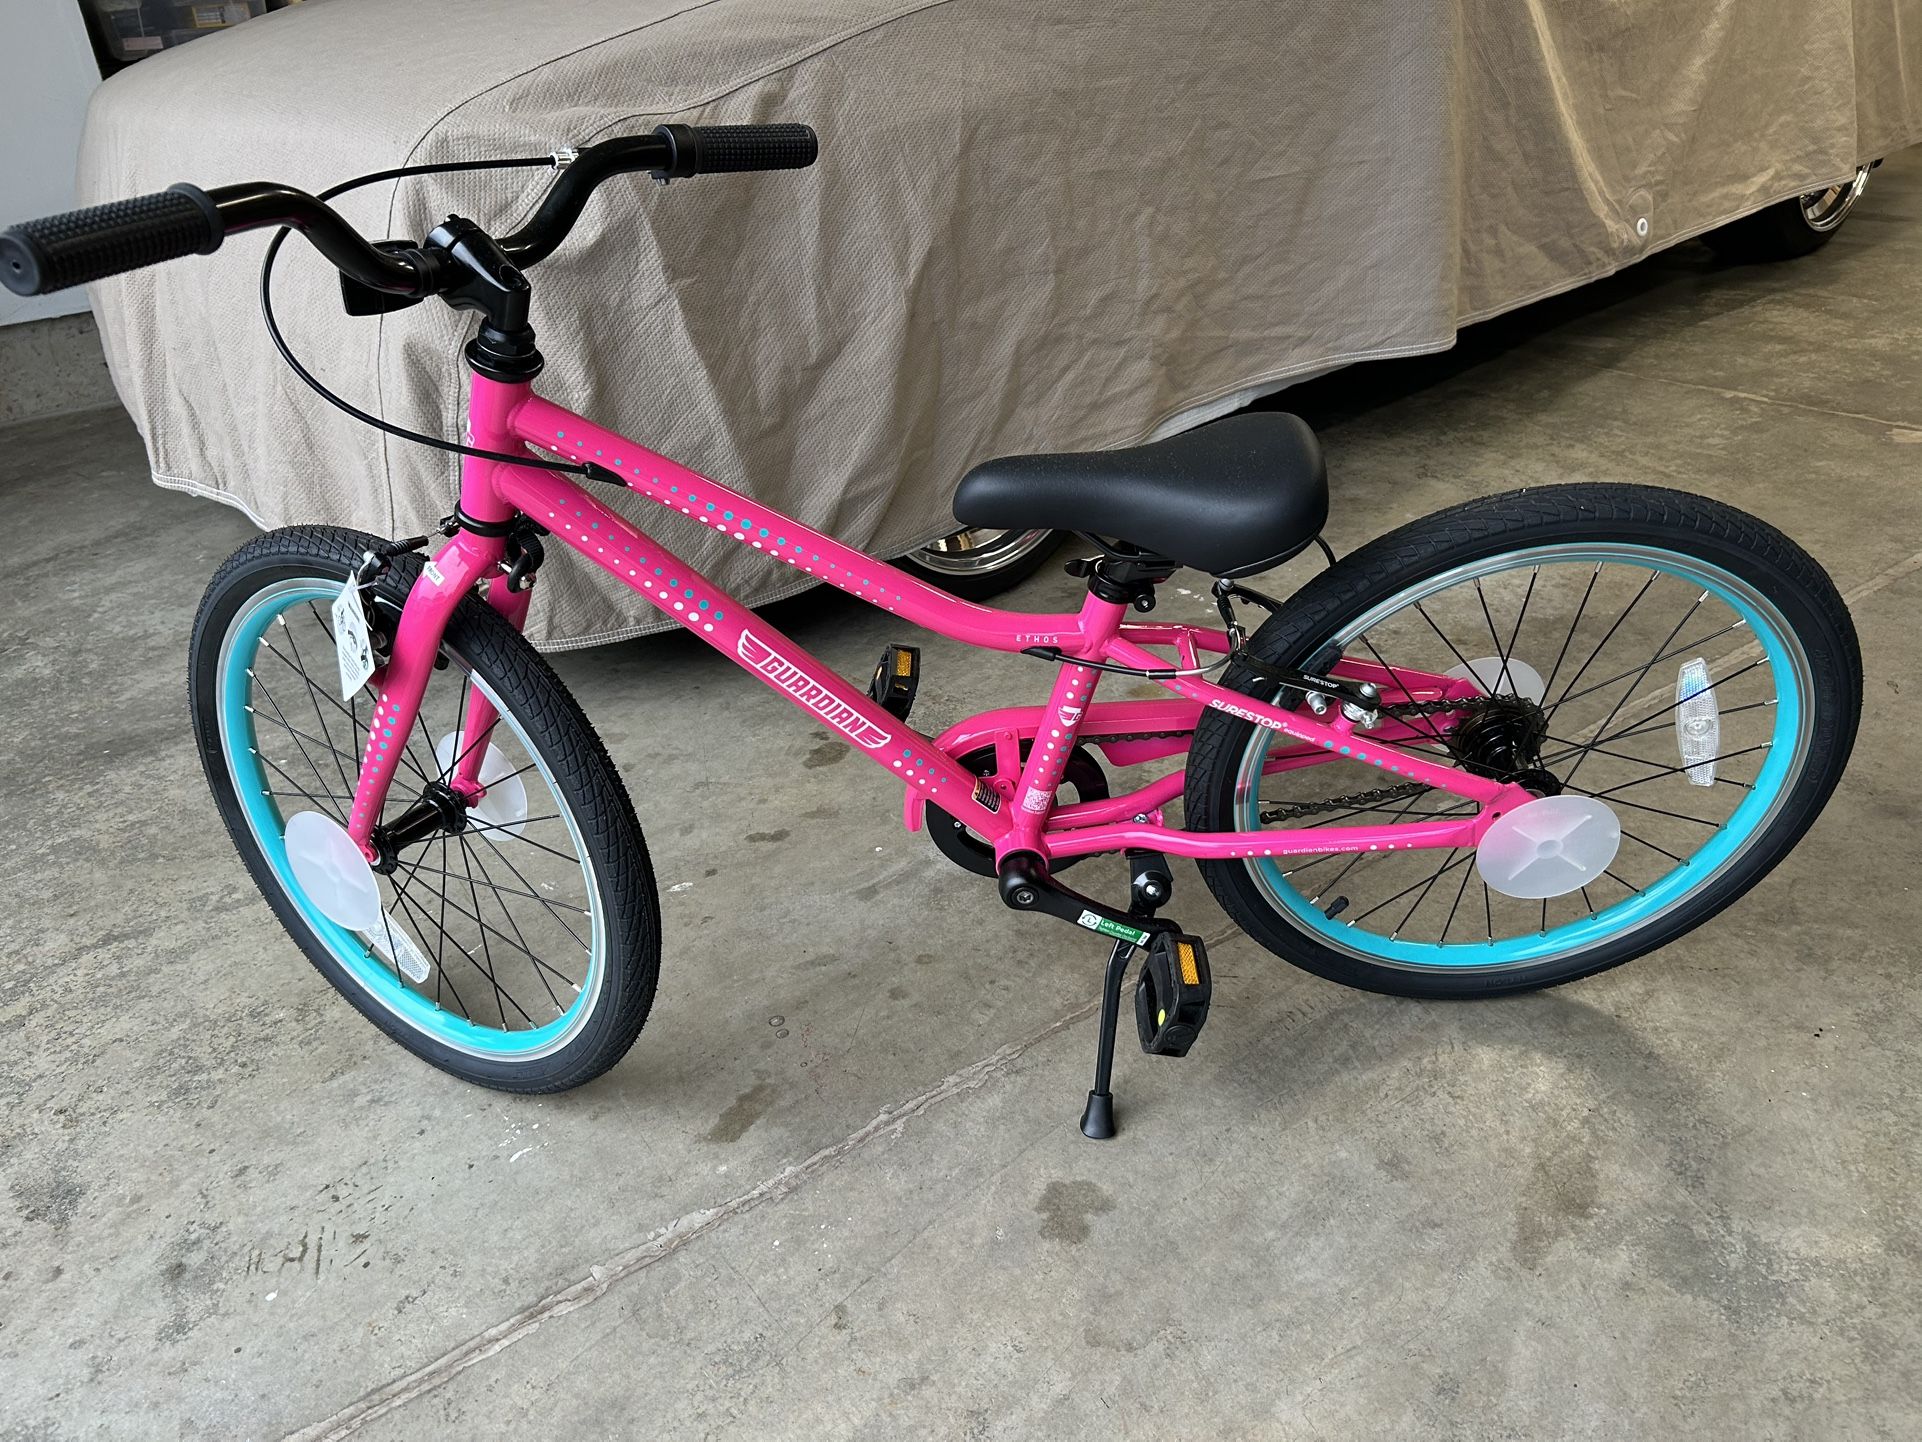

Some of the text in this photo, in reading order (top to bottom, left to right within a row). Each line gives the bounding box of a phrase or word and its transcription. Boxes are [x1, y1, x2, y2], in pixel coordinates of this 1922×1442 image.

[1016, 634, 1058, 644] ETHOS
[759, 654, 867, 738] GUARDIAN
[1284, 728, 1316, 742] equipped
[1283, 846, 1358, 855] guardianbikes.com
[1100, 920, 1115, 930] Left
[1115, 925, 1136, 936] Pedal
